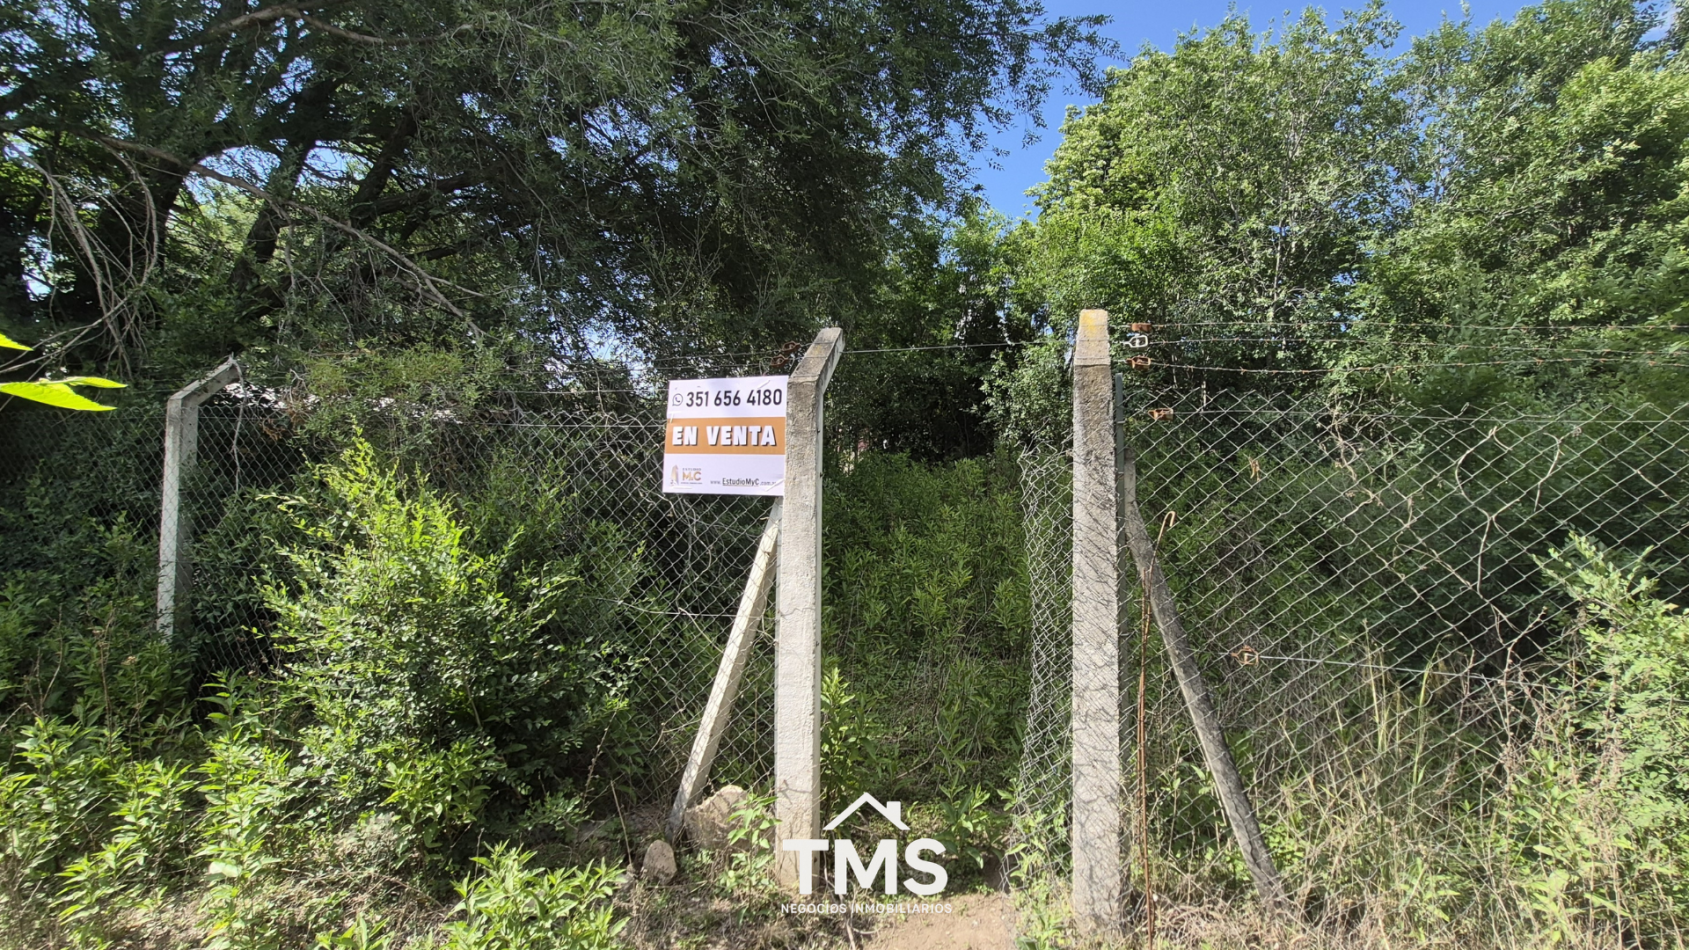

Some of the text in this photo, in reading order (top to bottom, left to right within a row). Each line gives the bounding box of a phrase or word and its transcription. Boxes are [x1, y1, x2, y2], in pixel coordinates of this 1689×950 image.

[686, 388, 783, 407] 351 656 4180
[672, 425, 777, 447] EN VENTA
